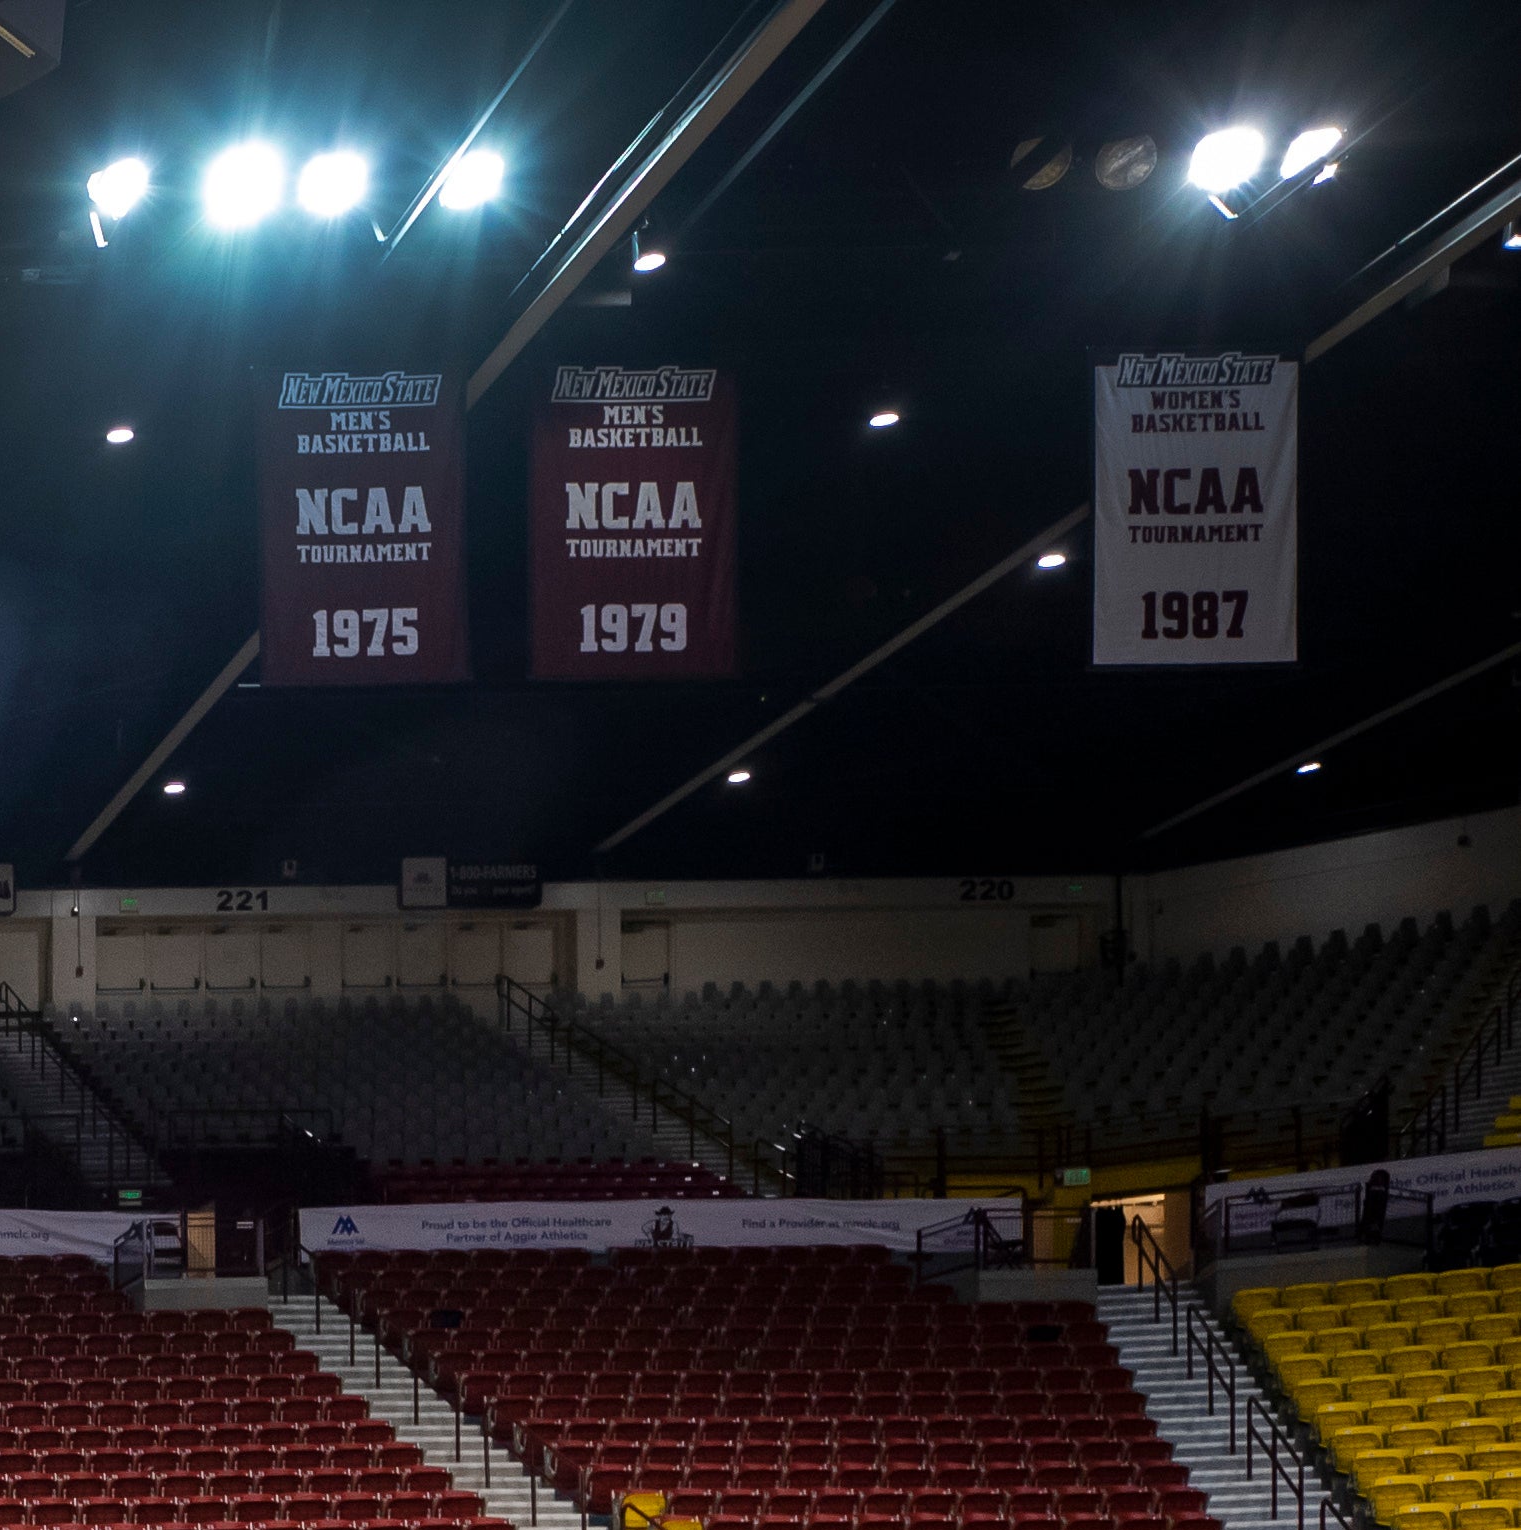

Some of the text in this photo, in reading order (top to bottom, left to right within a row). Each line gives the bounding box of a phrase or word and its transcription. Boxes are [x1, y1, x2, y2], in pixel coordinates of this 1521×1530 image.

[1151, 390, 1240, 410] WOMEN'S
[330, 411, 390, 432] MEN'S
[603, 406, 663, 425] MEN'S
[1132, 412, 1265, 433] BASKETBALL
[298, 432, 430, 454] BASKETBALL
[569, 428, 702, 448] BASKETBALL
[1128, 467, 1264, 515] NCAA
[296, 486, 432, 535] NCAA
[566, 481, 702, 529] NCAA
[1129, 524, 1263, 543] TOURNAMENT
[297, 542, 432, 563] TOURNAMENT
[566, 538, 702, 558] TOURNAMENT
[1142, 590, 1248, 639] 1987
[312, 608, 418, 657] 1975
[580, 604, 687, 653] 1979
[216, 890, 269, 912] 221
[959, 879, 1014, 901] 220
